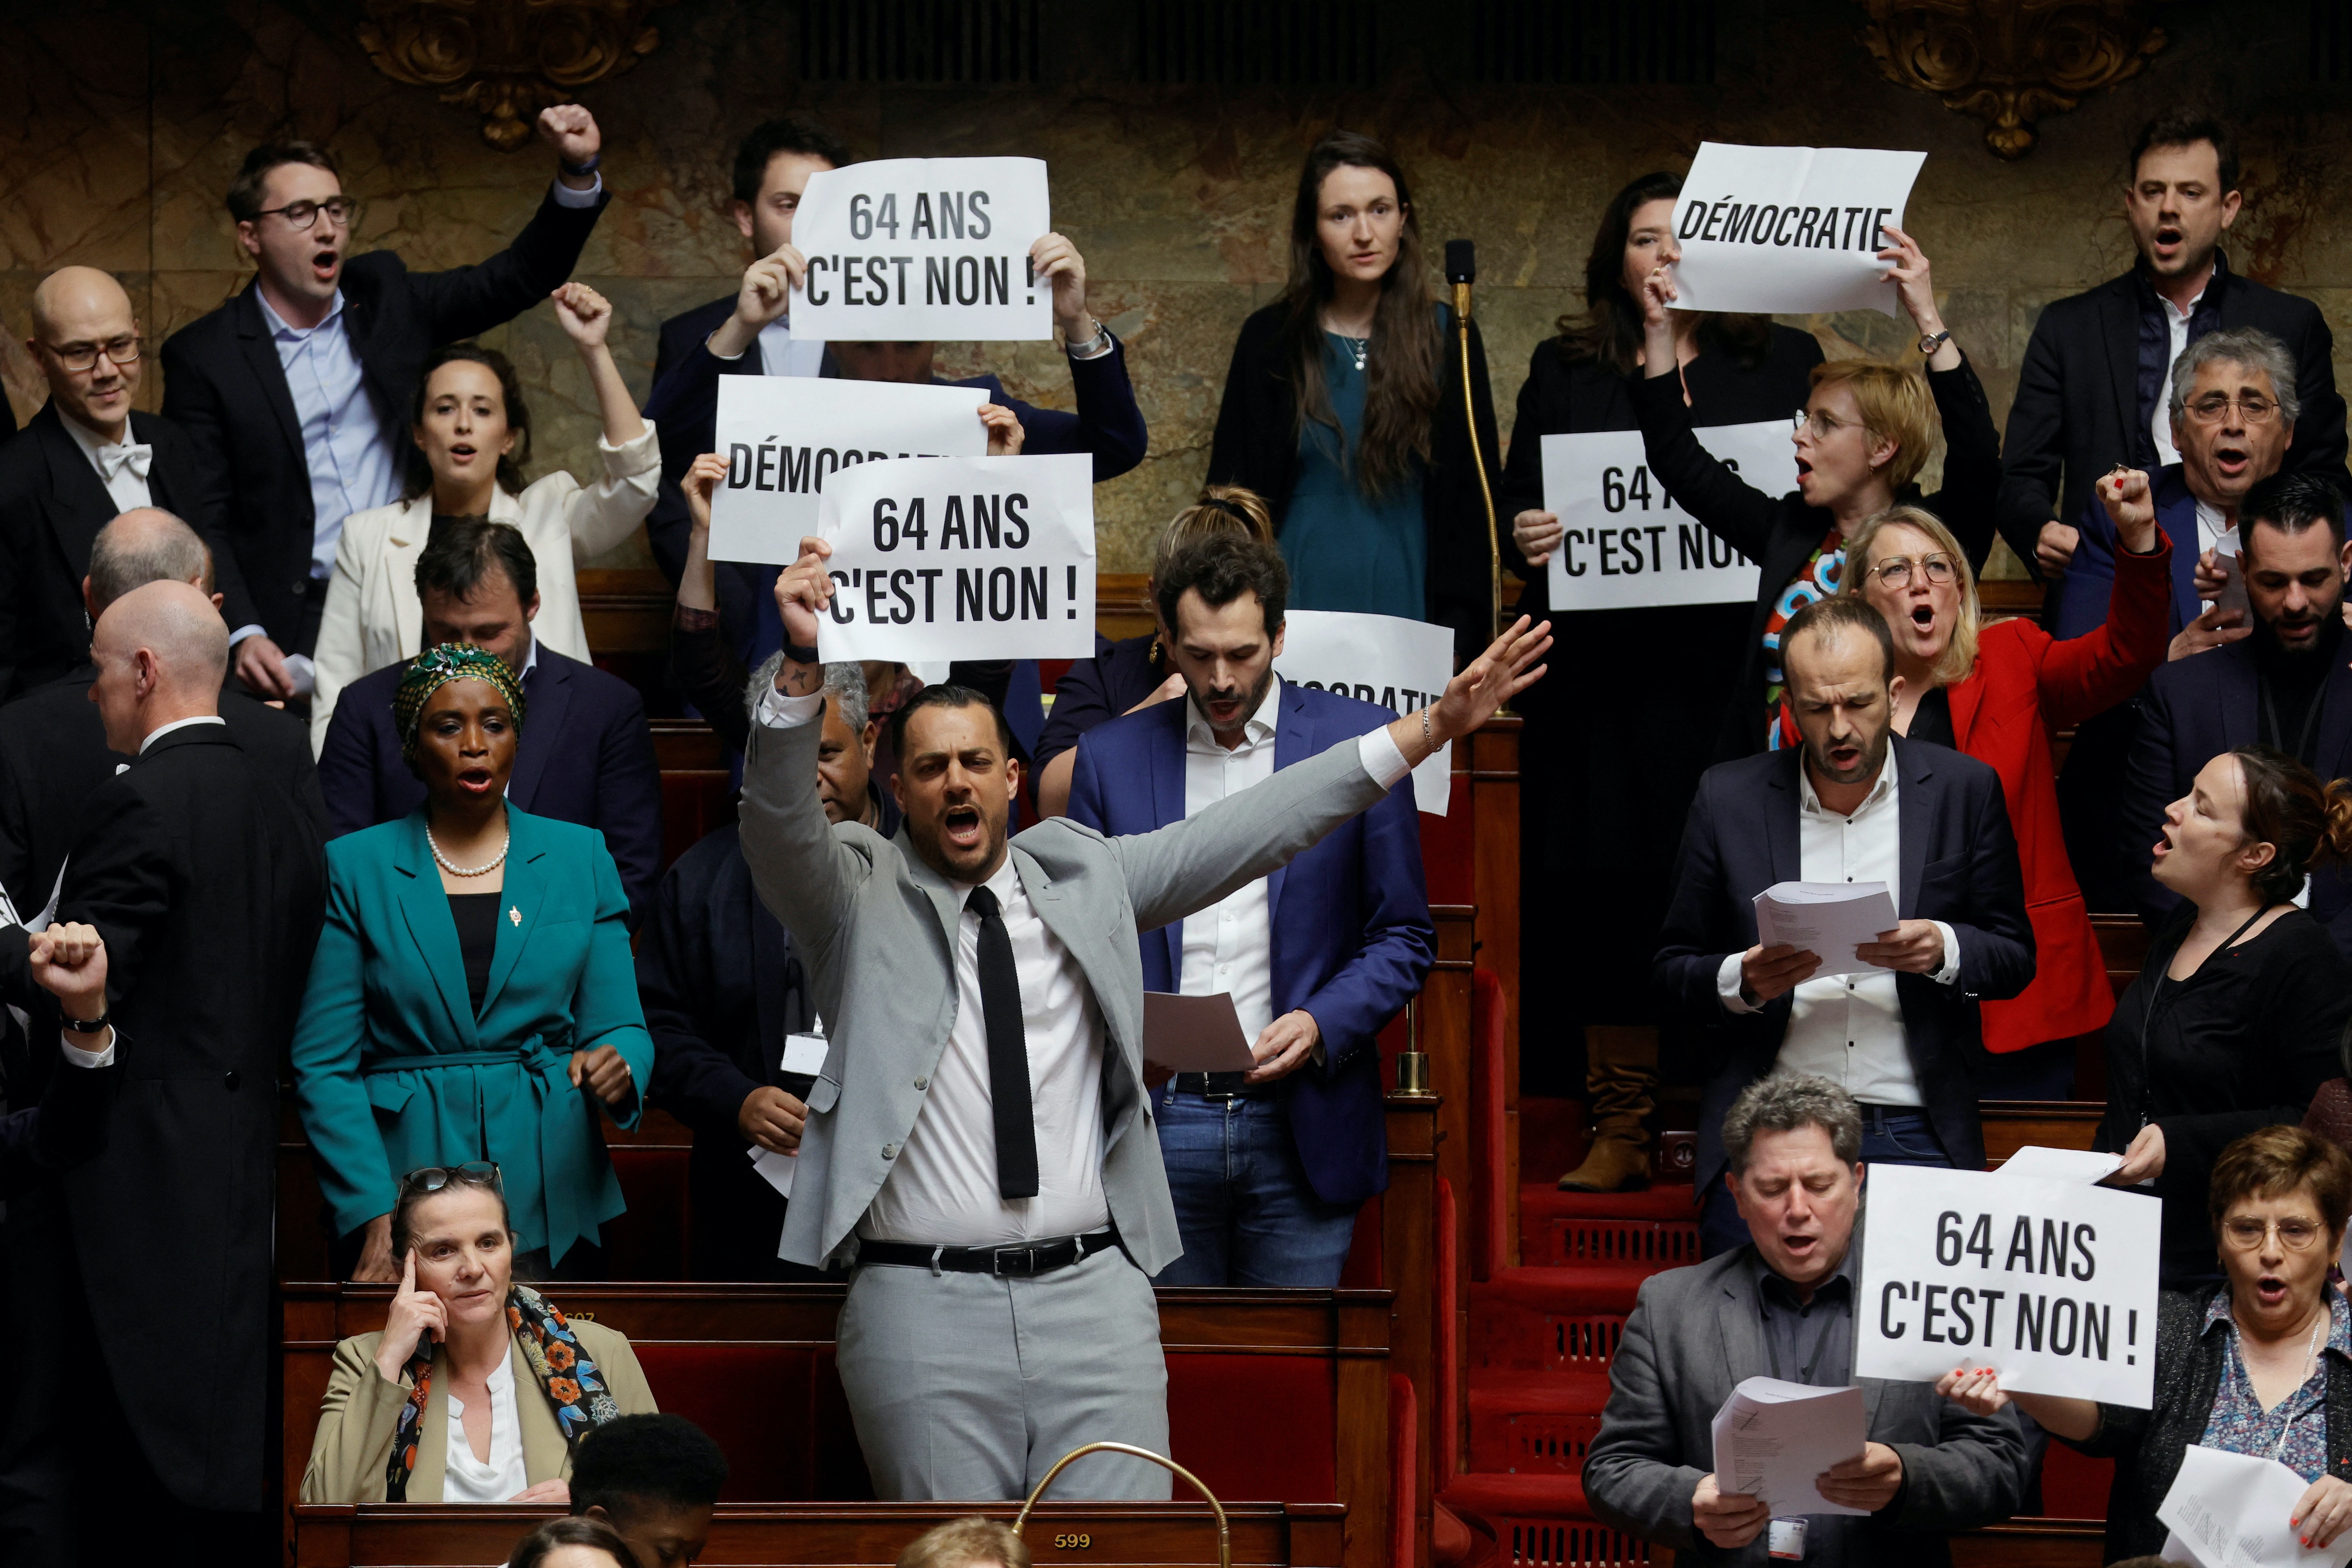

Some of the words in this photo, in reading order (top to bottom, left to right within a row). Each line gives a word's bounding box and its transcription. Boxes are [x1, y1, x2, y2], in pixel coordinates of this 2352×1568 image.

[850, 193, 900, 240] 64
[912, 191, 991, 240] ANS
[1678, 195, 1893, 252] DÉMOCRATIE
[807, 255, 913, 306] C'EST
[926, 256, 1009, 306] NON
[1026, 256, 1034, 305] !
[1602, 466, 1652, 513] 64
[873, 498, 928, 552] 64
[940, 493, 1030, 550] ANS
[1564, 526, 1666, 577] C'EST
[1678, 523, 1762, 570] NO
[828, 568, 943, 625] C'EST
[956, 566, 1047, 622] NON
[1067, 565, 1076, 619] !
[1936, 1210, 1993, 1269] 64
[2004, 1216, 2096, 1282] ANS
[1880, 1281, 2005, 1347] C'EST
[2015, 1293, 2110, 1361] NON
[2127, 1309, 2137, 1366] !
[1055, 1534, 1090, 1548] 599
